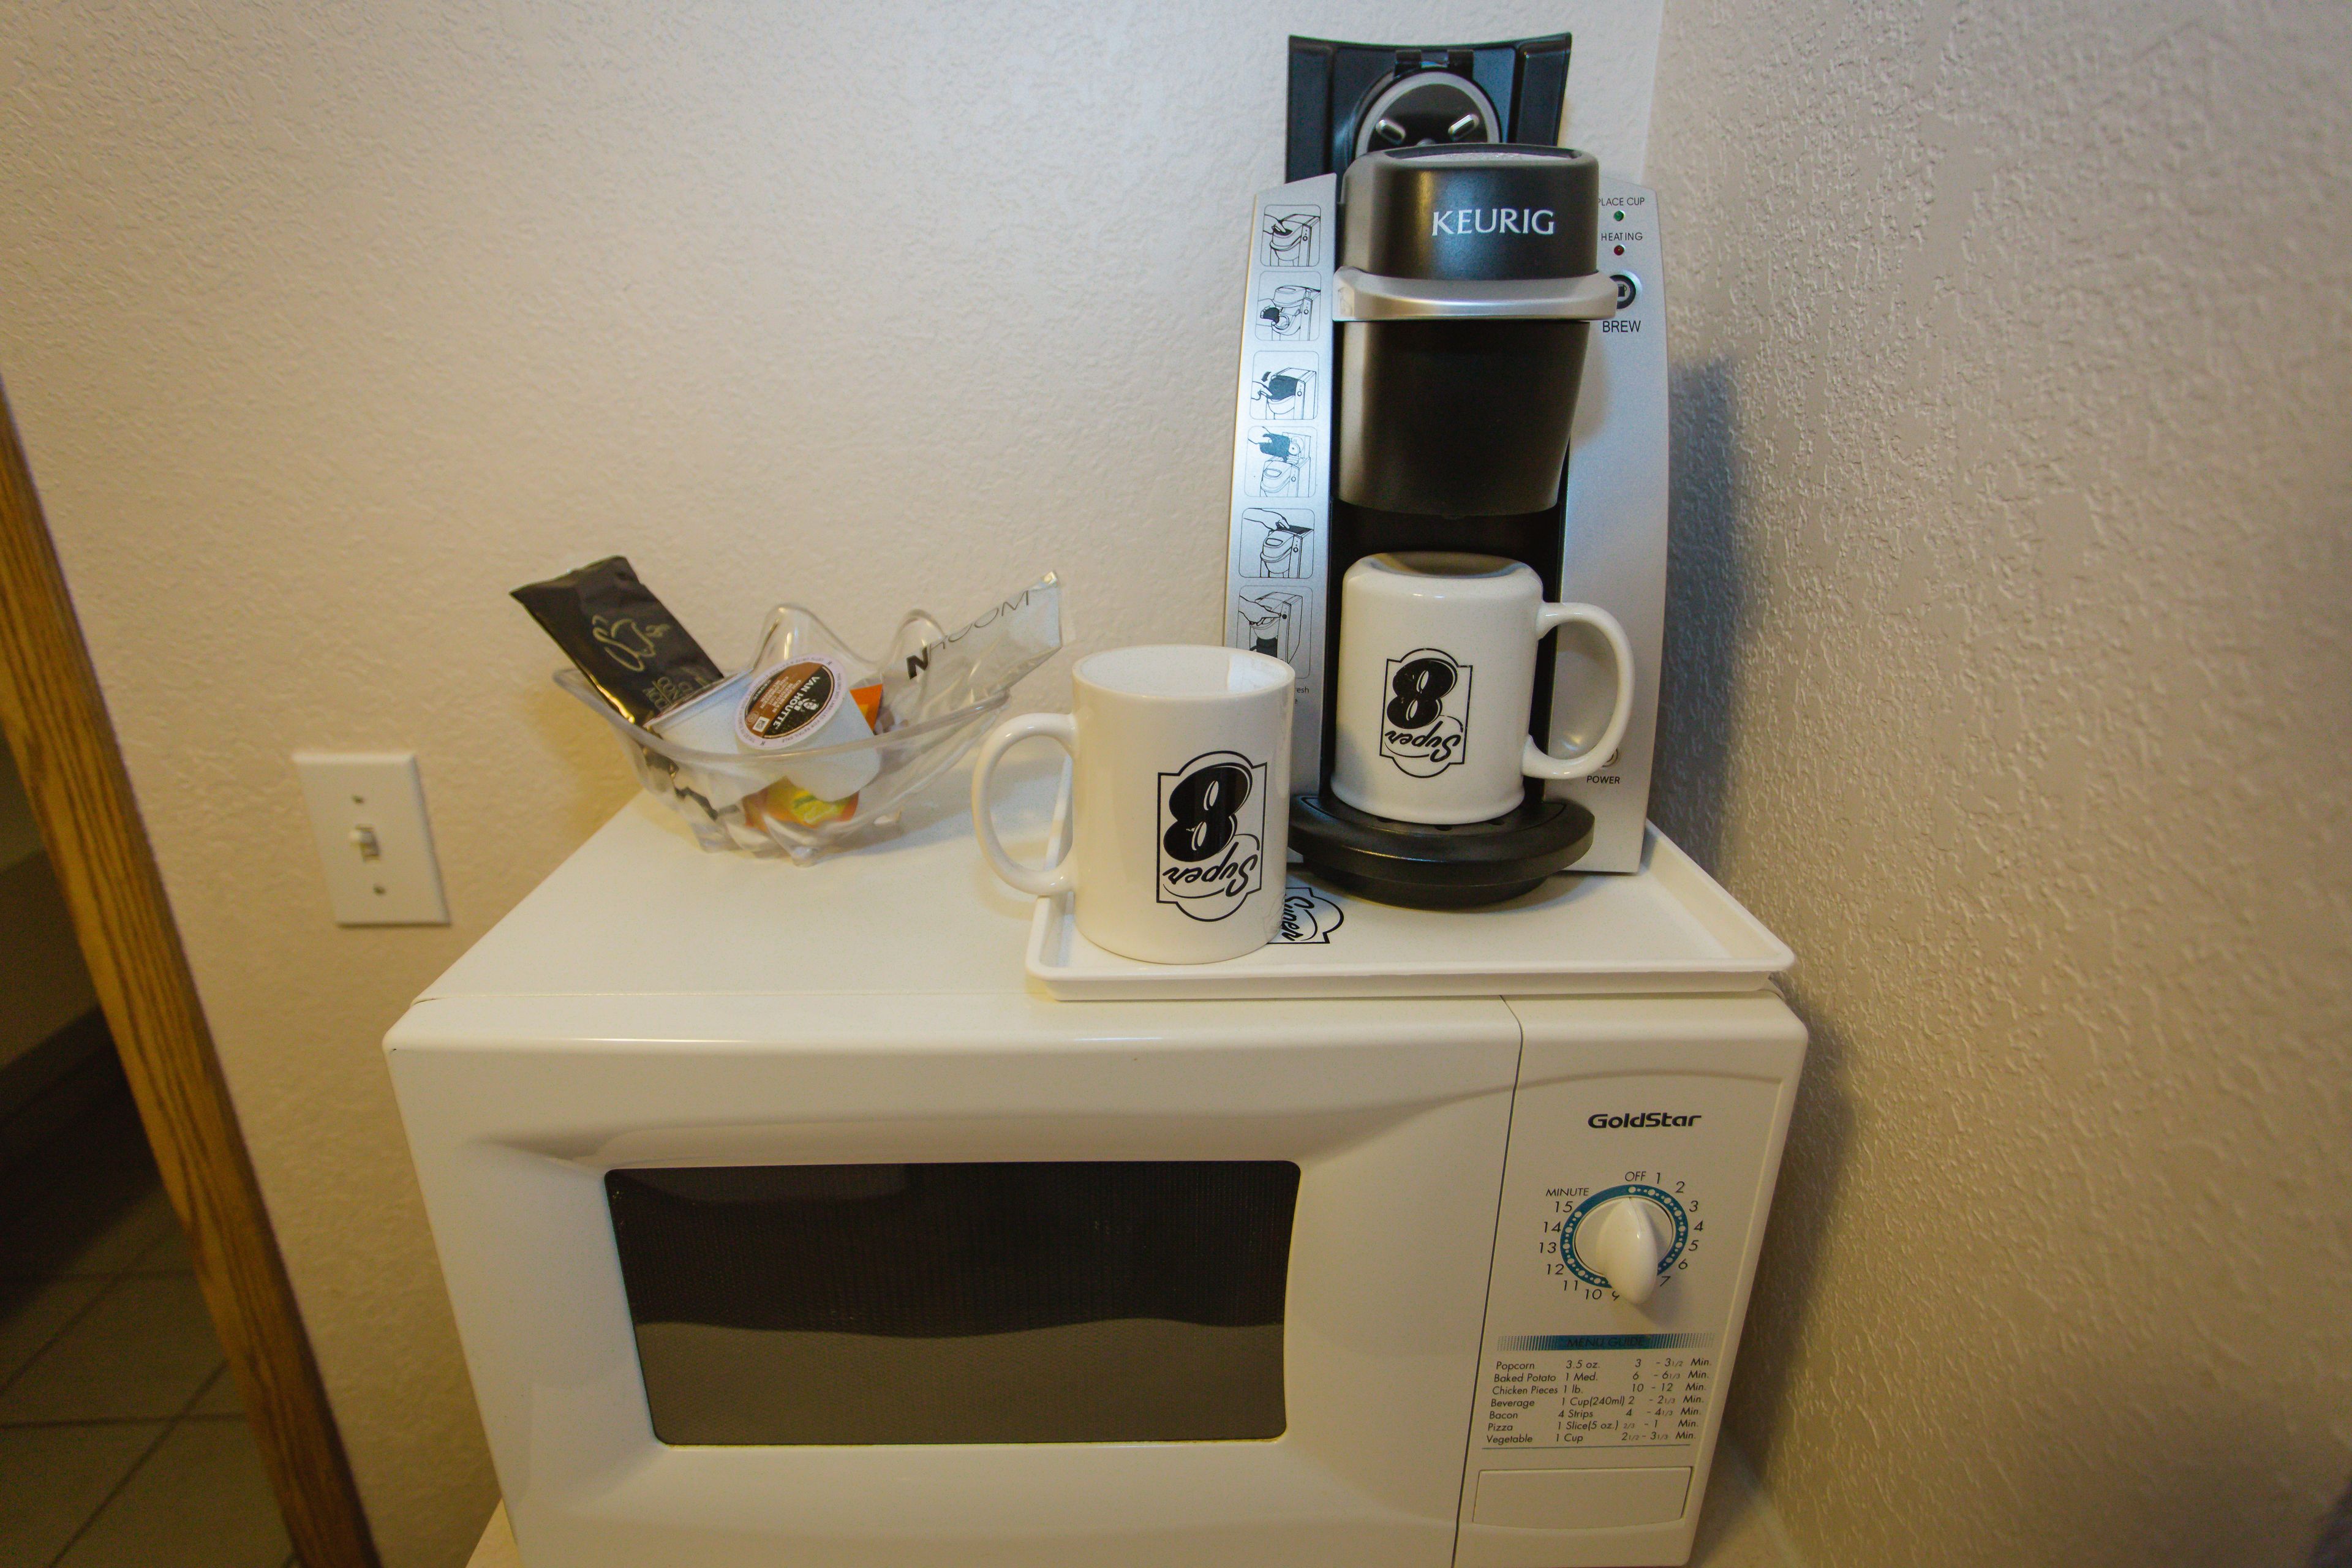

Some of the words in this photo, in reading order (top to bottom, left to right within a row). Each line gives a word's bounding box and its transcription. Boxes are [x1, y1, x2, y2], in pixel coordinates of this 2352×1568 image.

[1627, 197, 1645, 206] CUP
[1431, 208, 1555, 236] KEURIG
[1601, 232, 1643, 241] HEATING
[1602, 320, 1641, 334] BREW
[799, 675, 821, 693] VAN
[1387, 658, 1458, 729] 8
[772, 692, 804, 728] HOUTTE
[1385, 721, 1461, 763] Super
[1586, 775, 1620, 784] POWER
[1163, 763, 1253, 862] 8
[1163, 842, 1258, 897] Super
[1588, 1112, 1702, 1128] GoldStar
[1624, 1170, 1646, 1182] OFF
[1656, 1172, 1661, 1184] 1
[1545, 1188, 1589, 1197] MINUTE
[1675, 1181, 1685, 1193] 2
[1555, 1200, 1574, 1213] 15
[1689, 1200, 1698, 1212] 3
[1544, 1221, 1561, 1233] 14
[1694, 1220, 1704, 1232] 4
[1539, 1242, 1557, 1253] 13
[1688, 1240, 1699, 1251] 5
[1546, 1264, 1564, 1275] 12
[1678, 1259, 1688, 1270] 6
[1564, 1280, 1578, 1291] 11
[1660, 1276, 1671, 1286] 7
[1585, 1289, 1602, 1300] 10
[1567, 1338, 1605, 1347] MENU
[1608, 1336, 1645, 1346] GUIDE
[1496, 1361, 1535, 1372] Popcorn
[1566, 1360, 1583, 1369] 3.5
[1635, 1359, 1642, 1367] 3
[1691, 1358, 1711, 1366] Min.
[1494, 1373, 1524, 1382] Baked
[1527, 1373, 1556, 1382] Potato
[1566, 1373, 1569, 1381] 1
[1574, 1372, 1598, 1381] Med.
[1632, 1371, 1639, 1380] 6
[1688, 1370, 1709, 1379] Min.
[1492, 1384, 1528, 1395] Chicken
[1531, 1385, 1558, 1394] Pieces
[1564, 1385, 1567, 1393] 1
[1572, 1384, 1583, 1393] lb.
[1632, 1383, 1644, 1392] 10
[1661, 1382, 1673, 1392] 12
[1686, 1382, 1706, 1391] Min.
[1491, 1398, 1535, 1409] Beverage
[1562, 1397, 1565, 1406] 1
[1628, 1396, 1635, 1404] 2
[1489, 1411, 1518, 1419] Bacon
[1558, 1409, 1564, 1418] 4
[1567, 1409, 1593, 1420] Strips
[1488, 1423, 1513, 1431] Pizza
[1558, 1422, 1561, 1430] 1
[1678, 1419, 1698, 1428] Min.
[1487, 1434, 1533, 1446] Vegetable
[1564, 1433, 1583, 1444] Cup
[1675, 1431, 1696, 1440] Min.
